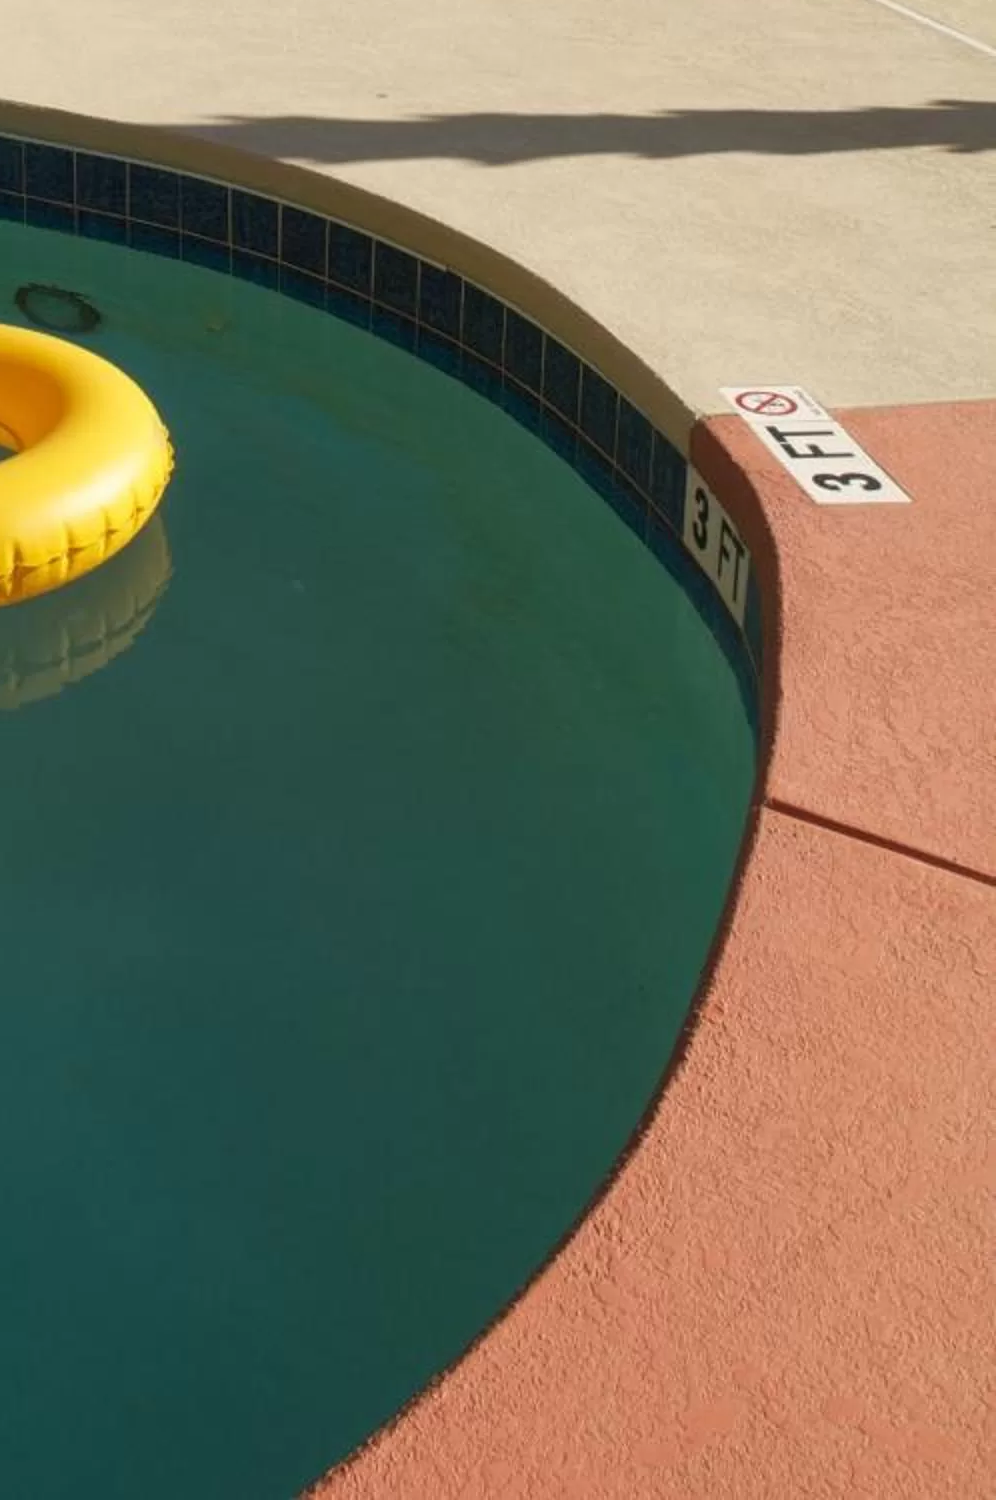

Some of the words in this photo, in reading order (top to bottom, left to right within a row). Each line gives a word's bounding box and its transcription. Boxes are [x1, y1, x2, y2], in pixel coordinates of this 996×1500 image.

[766, 425, 856, 459] FT
[812, 472, 882, 492] 3
[692, 487, 709, 550] 3
[717, 516, 745, 602] FT
